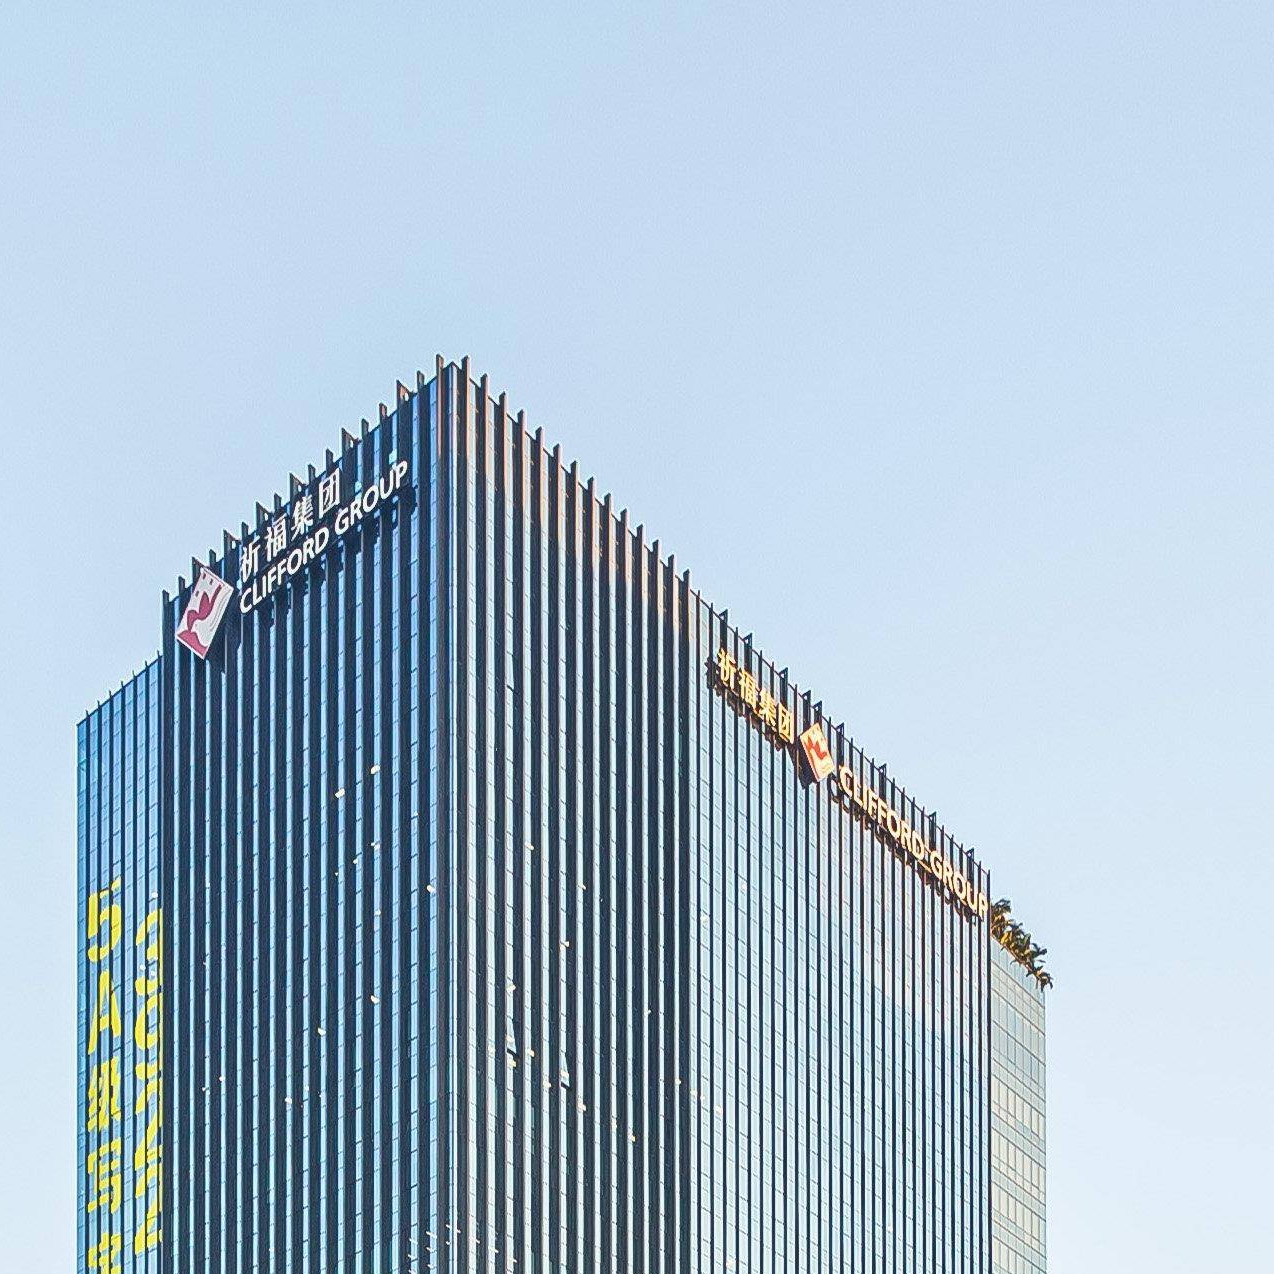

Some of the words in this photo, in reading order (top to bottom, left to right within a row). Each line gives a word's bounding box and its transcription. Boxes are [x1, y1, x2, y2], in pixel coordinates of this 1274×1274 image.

[239, 526, 331, 615] CLIFFORD
[335, 459, 409, 536] GROUP
[240, 467, 342, 584] 祈福集团
[717, 647, 796, 745] 祈福集团
[839, 765, 925, 862] CLIFFORD
[929, 849, 989, 917] GROUP
